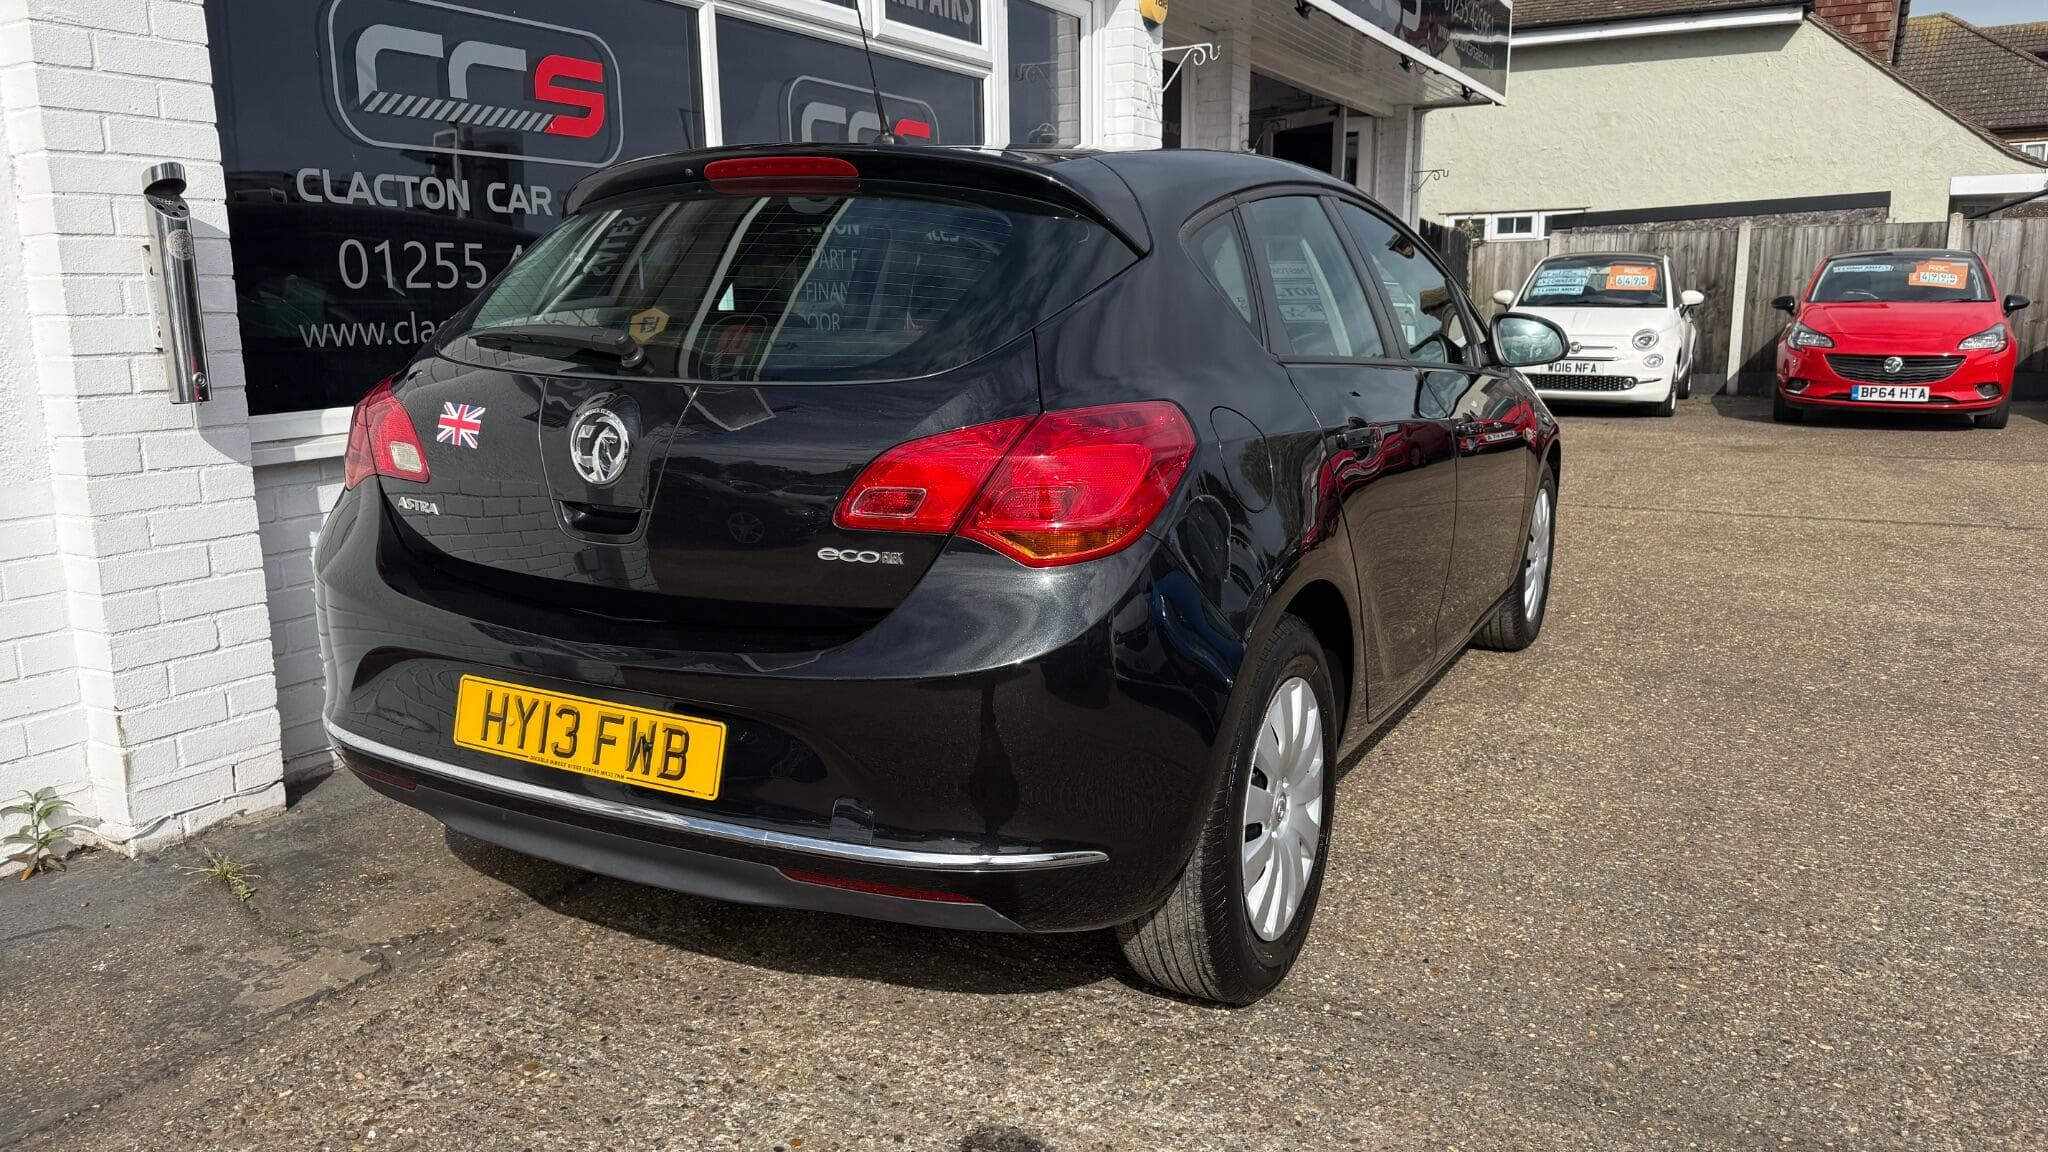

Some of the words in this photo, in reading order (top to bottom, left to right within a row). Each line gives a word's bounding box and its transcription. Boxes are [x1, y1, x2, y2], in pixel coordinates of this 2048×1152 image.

[296, 167, 471, 212] CLACTON
[486, 182, 553, 216] CAR
[338, 238, 487, 290] 01255
[298, 311, 445, 348] www.cla
[1574, 362, 1597, 374] NFA
[1861, 386, 1896, 399] BP64
[1899, 387, 1926, 400] HTA
[398, 496, 440, 516] ASTRA
[479, 689, 581, 759] HY13
[591, 711, 690, 782] FWB
